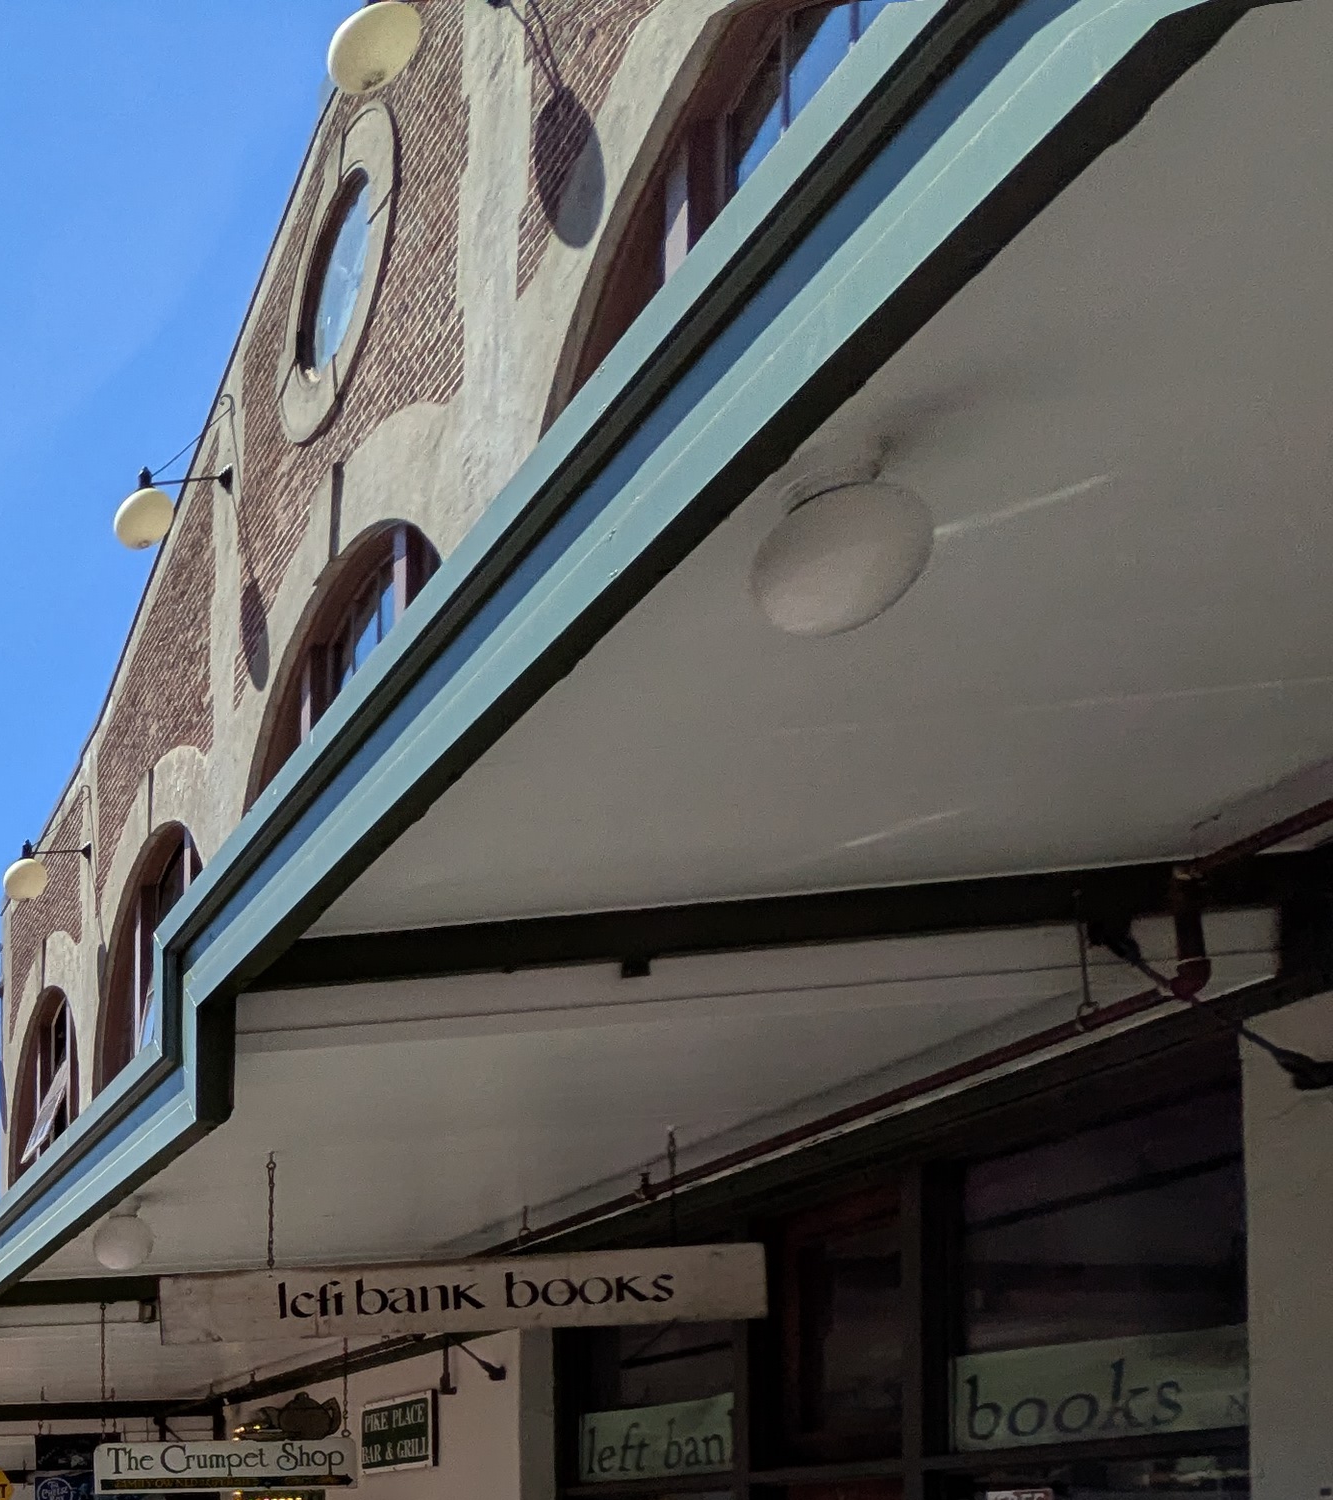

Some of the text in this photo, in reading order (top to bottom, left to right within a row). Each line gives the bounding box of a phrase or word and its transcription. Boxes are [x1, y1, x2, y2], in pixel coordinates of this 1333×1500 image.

[355, 1276, 487, 1316] bank
[504, 1270, 676, 1310] books
[364, 1402, 425, 1433] PIKE PLACE
[965, 1357, 1185, 1441] books
[107, 1443, 345, 1476] The Crumpet Shop
[361, 1436, 429, 1464] BAR & GRILL
[586, 1409, 734, 1475] left ban
